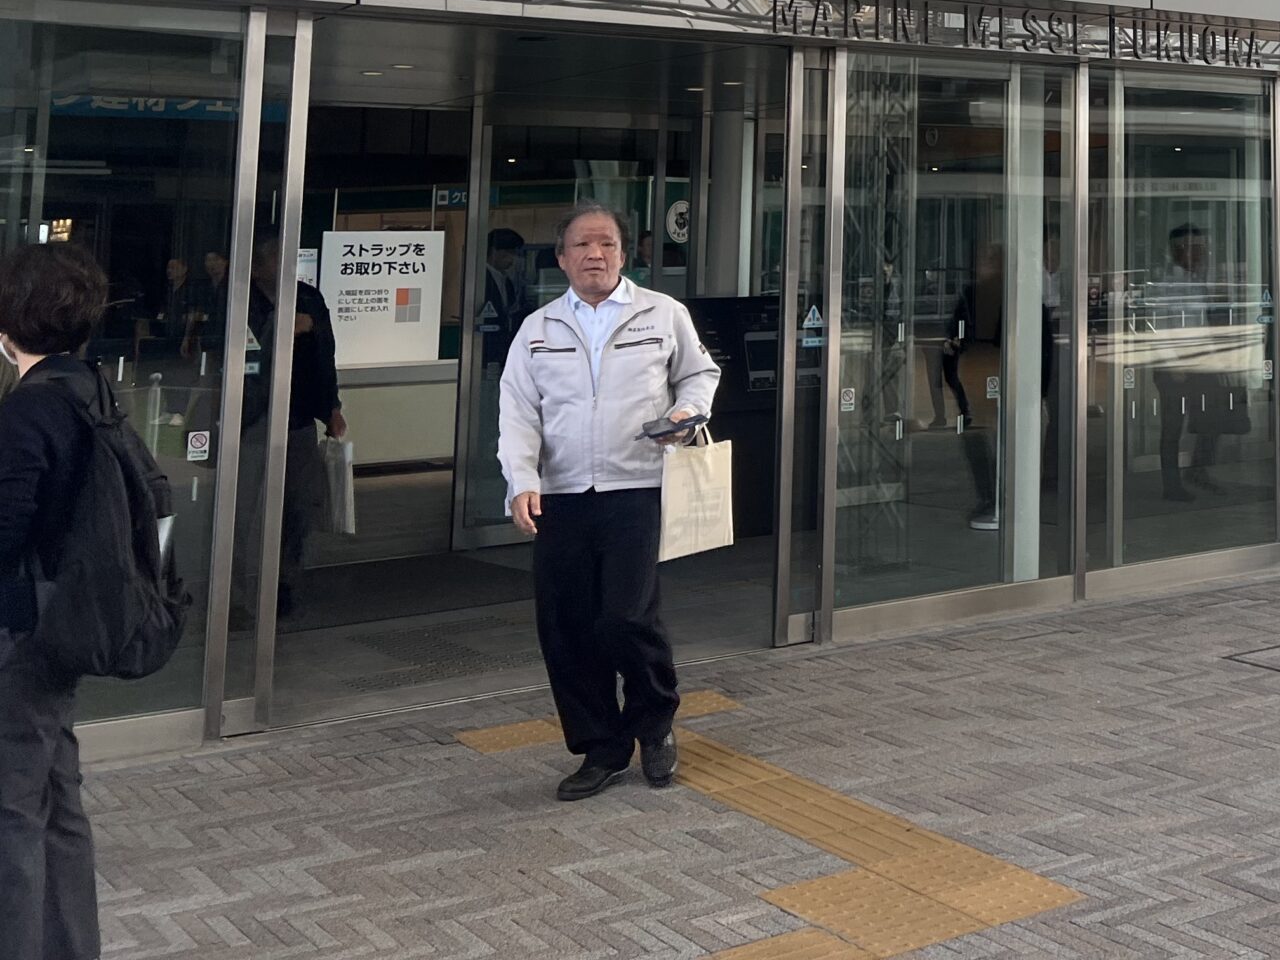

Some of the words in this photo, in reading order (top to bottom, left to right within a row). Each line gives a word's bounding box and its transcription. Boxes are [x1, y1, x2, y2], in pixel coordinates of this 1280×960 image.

[342, 243, 426, 258] ストラップを
[340, 261, 426, 276] お取り下さい
[337, 314, 357, 322] 下さい
